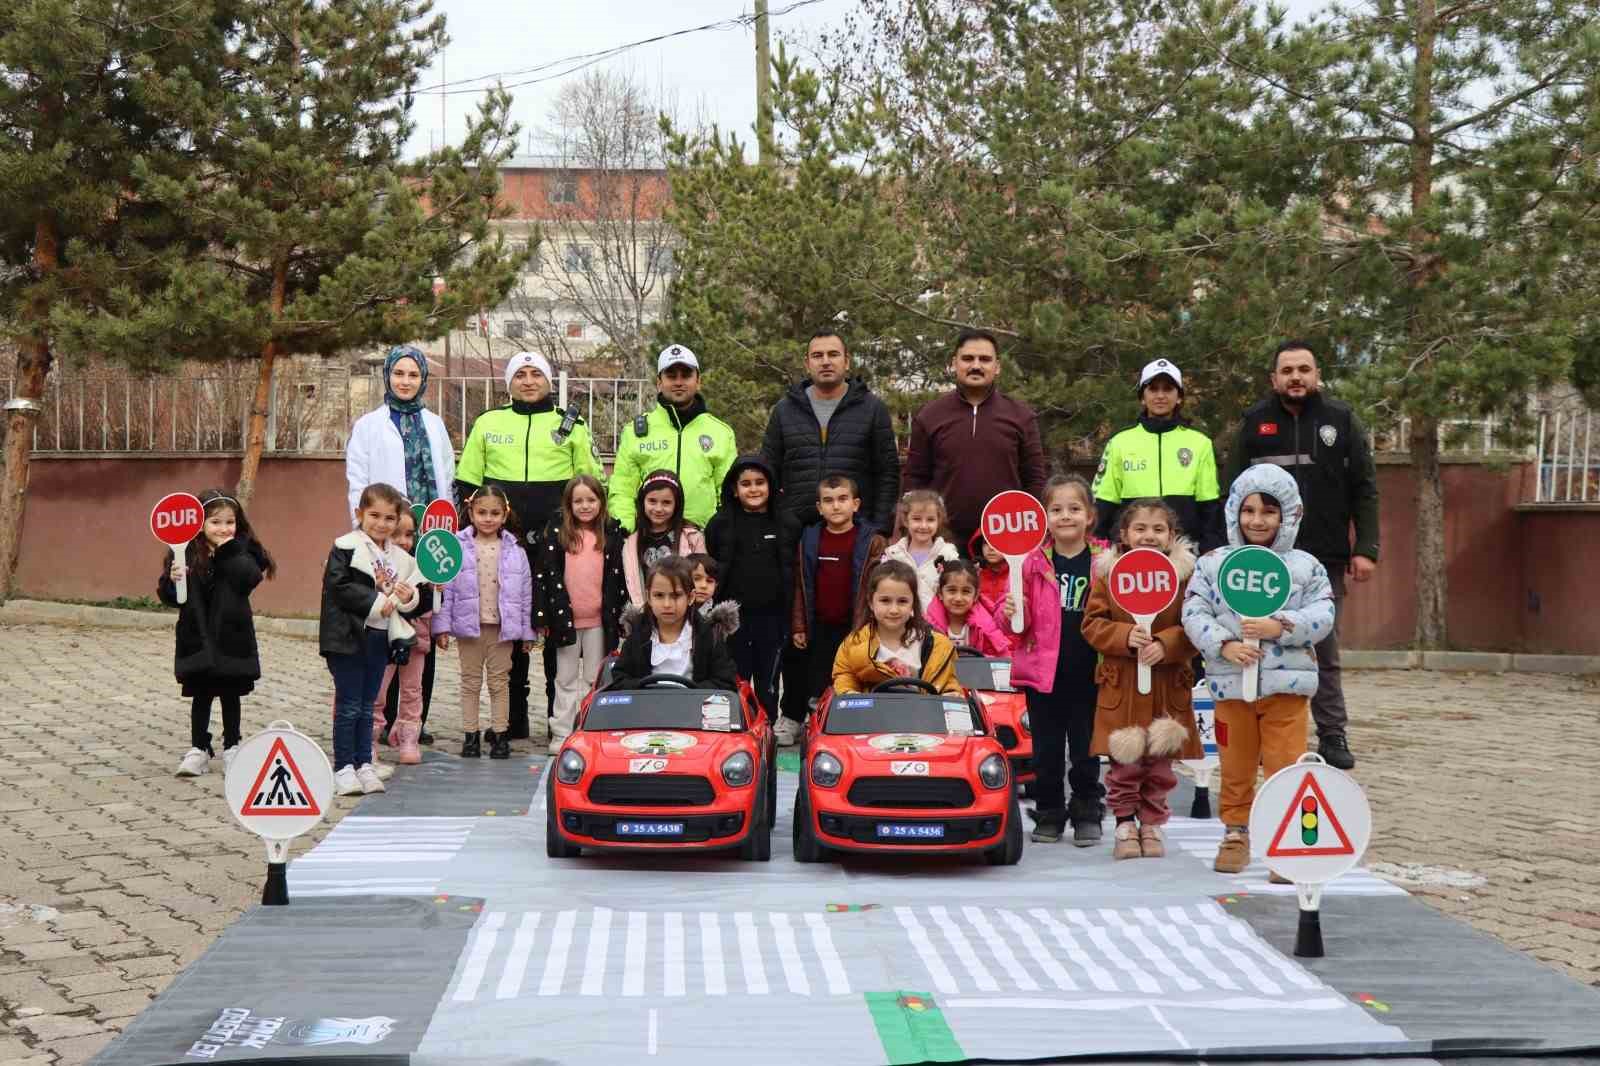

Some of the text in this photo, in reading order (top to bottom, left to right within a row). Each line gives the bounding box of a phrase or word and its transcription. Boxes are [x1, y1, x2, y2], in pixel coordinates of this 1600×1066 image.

[157, 508, 198, 529] DUR
[425, 514, 454, 531] DUR
[987, 510, 1039, 535] DUR
[425, 535, 455, 575] GEÇ
[1117, 570, 1171, 594] DUR
[1226, 568, 1281, 599] GEÇ
[633, 824, 646, 833] 25
[647, 824, 656, 833] A
[894, 826, 906, 835] 25
[908, 826, 917, 835] A
